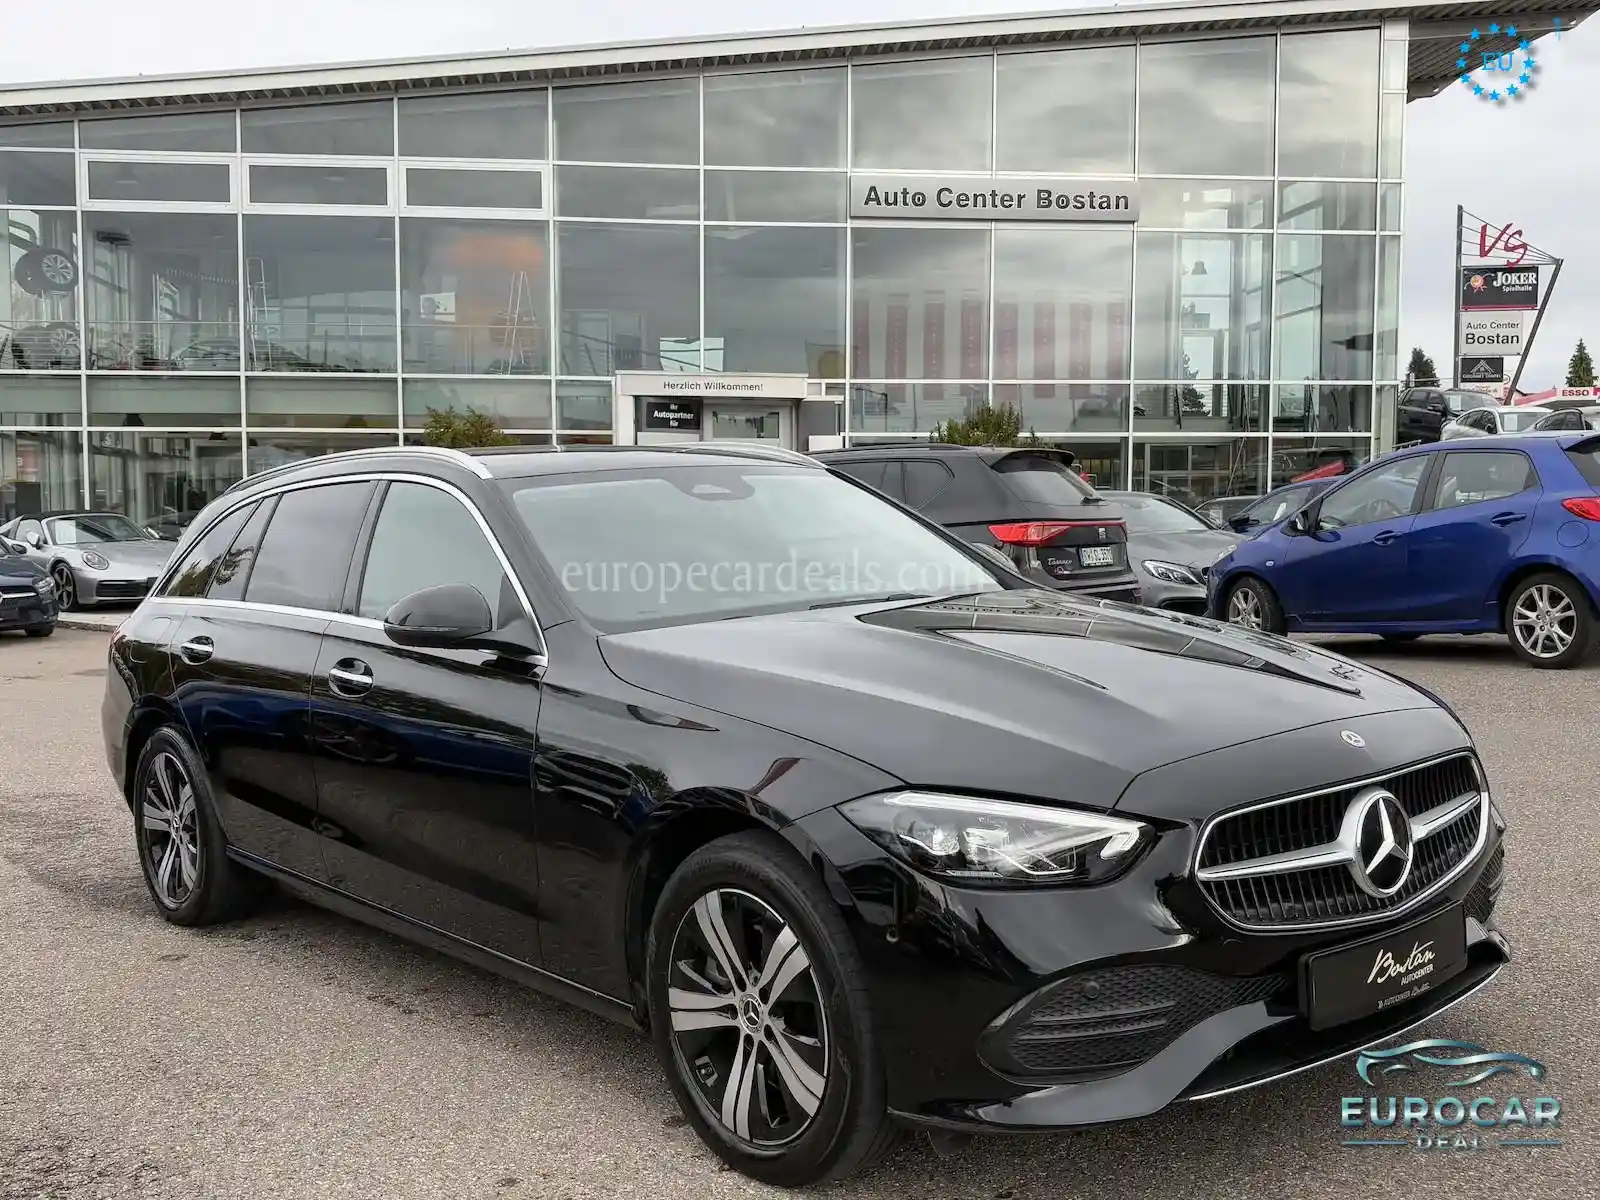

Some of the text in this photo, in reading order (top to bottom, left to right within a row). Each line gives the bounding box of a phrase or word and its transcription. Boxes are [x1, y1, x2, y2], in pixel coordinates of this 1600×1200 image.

[864, 185, 1129, 211] Auto Center Bostan
[1479, 223, 1528, 267] VS
[1493, 272, 1537, 285] JOKER
[1502, 285, 1533, 293] Spielhalle
[1466, 321, 1520, 330] Auto Center
[1465, 333, 1520, 345] Bostan
[663, 381, 764, 391] Herzlich Willkommen!
[653, 410, 694, 420] Autopartner
[1367, 941, 1435, 983] Bostan
[1400, 963, 1434, 985] AUTOCENTER
